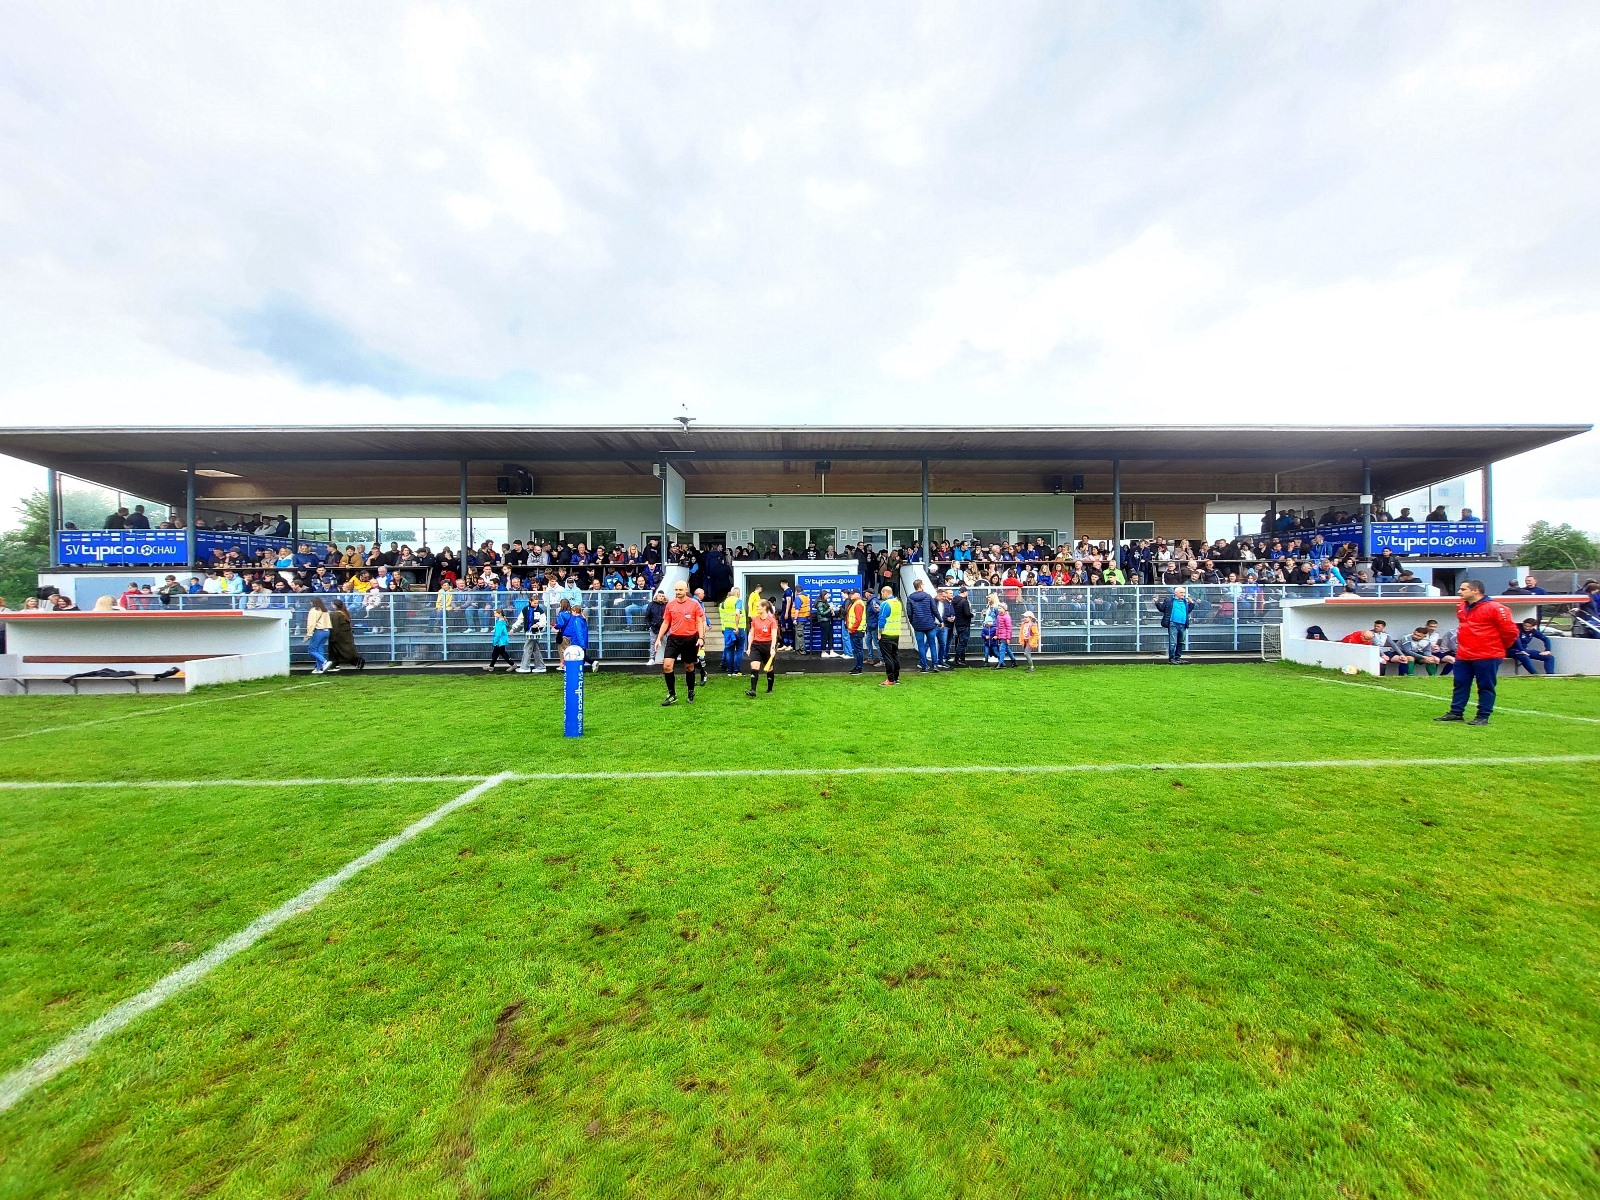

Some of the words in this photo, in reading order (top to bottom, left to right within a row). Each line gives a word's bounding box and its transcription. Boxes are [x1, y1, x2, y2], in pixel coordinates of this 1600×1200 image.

[1377, 535, 1390, 546] SV
[1391, 535, 1440, 551] typico
[65, 544, 80, 555] SV
[81, 544, 135, 561] typico
